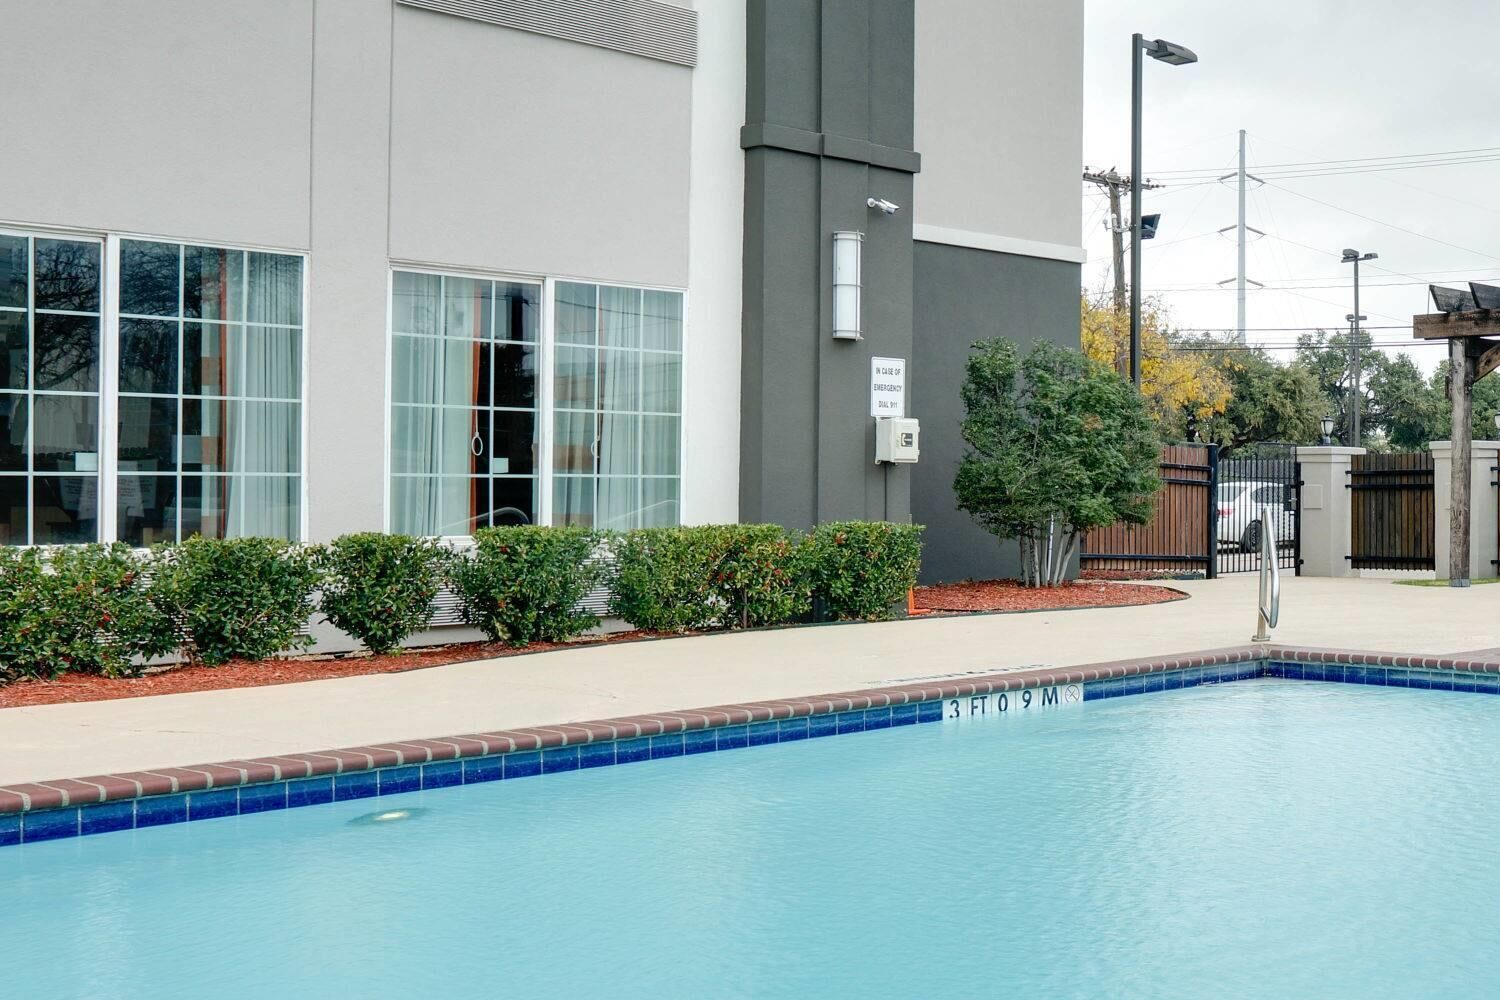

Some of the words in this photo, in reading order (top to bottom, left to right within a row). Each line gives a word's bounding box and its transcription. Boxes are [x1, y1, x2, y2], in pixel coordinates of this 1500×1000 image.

[875, 367, 881, 375] IN
[881, 367, 894, 376] CASE
[895, 368, 901, 376] OF
[873, 383, 902, 392] EMERGENCY
[878, 400, 889, 408] DIAL
[890, 400, 898, 408] 911
[949, 699, 960, 718] 3
[970, 695, 988, 716] FT
[1041, 686, 1059, 706] M
